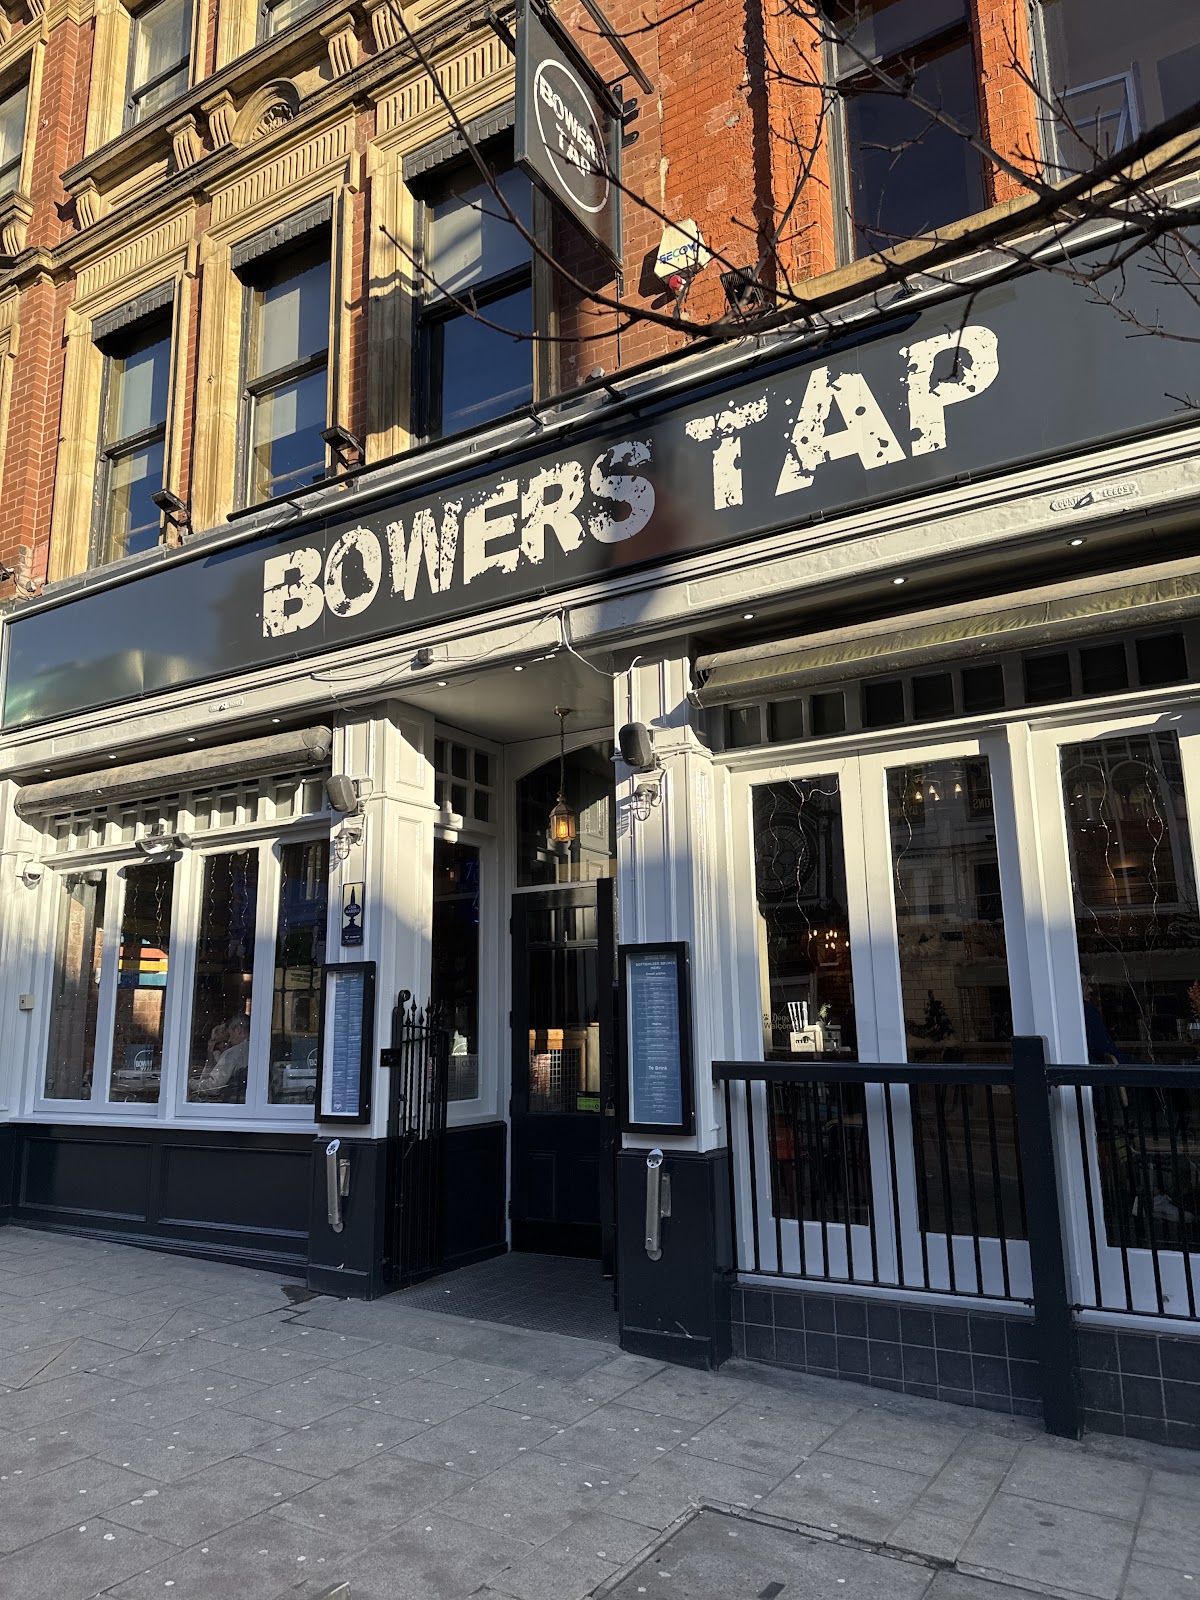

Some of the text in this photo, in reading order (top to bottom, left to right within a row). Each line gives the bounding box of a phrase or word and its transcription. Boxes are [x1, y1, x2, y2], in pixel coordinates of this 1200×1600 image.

[555, 122, 591, 177] TAP
[262, 325, 1000, 638] BOWERS TAP
[772, 1013, 790, 1024] Dogs
